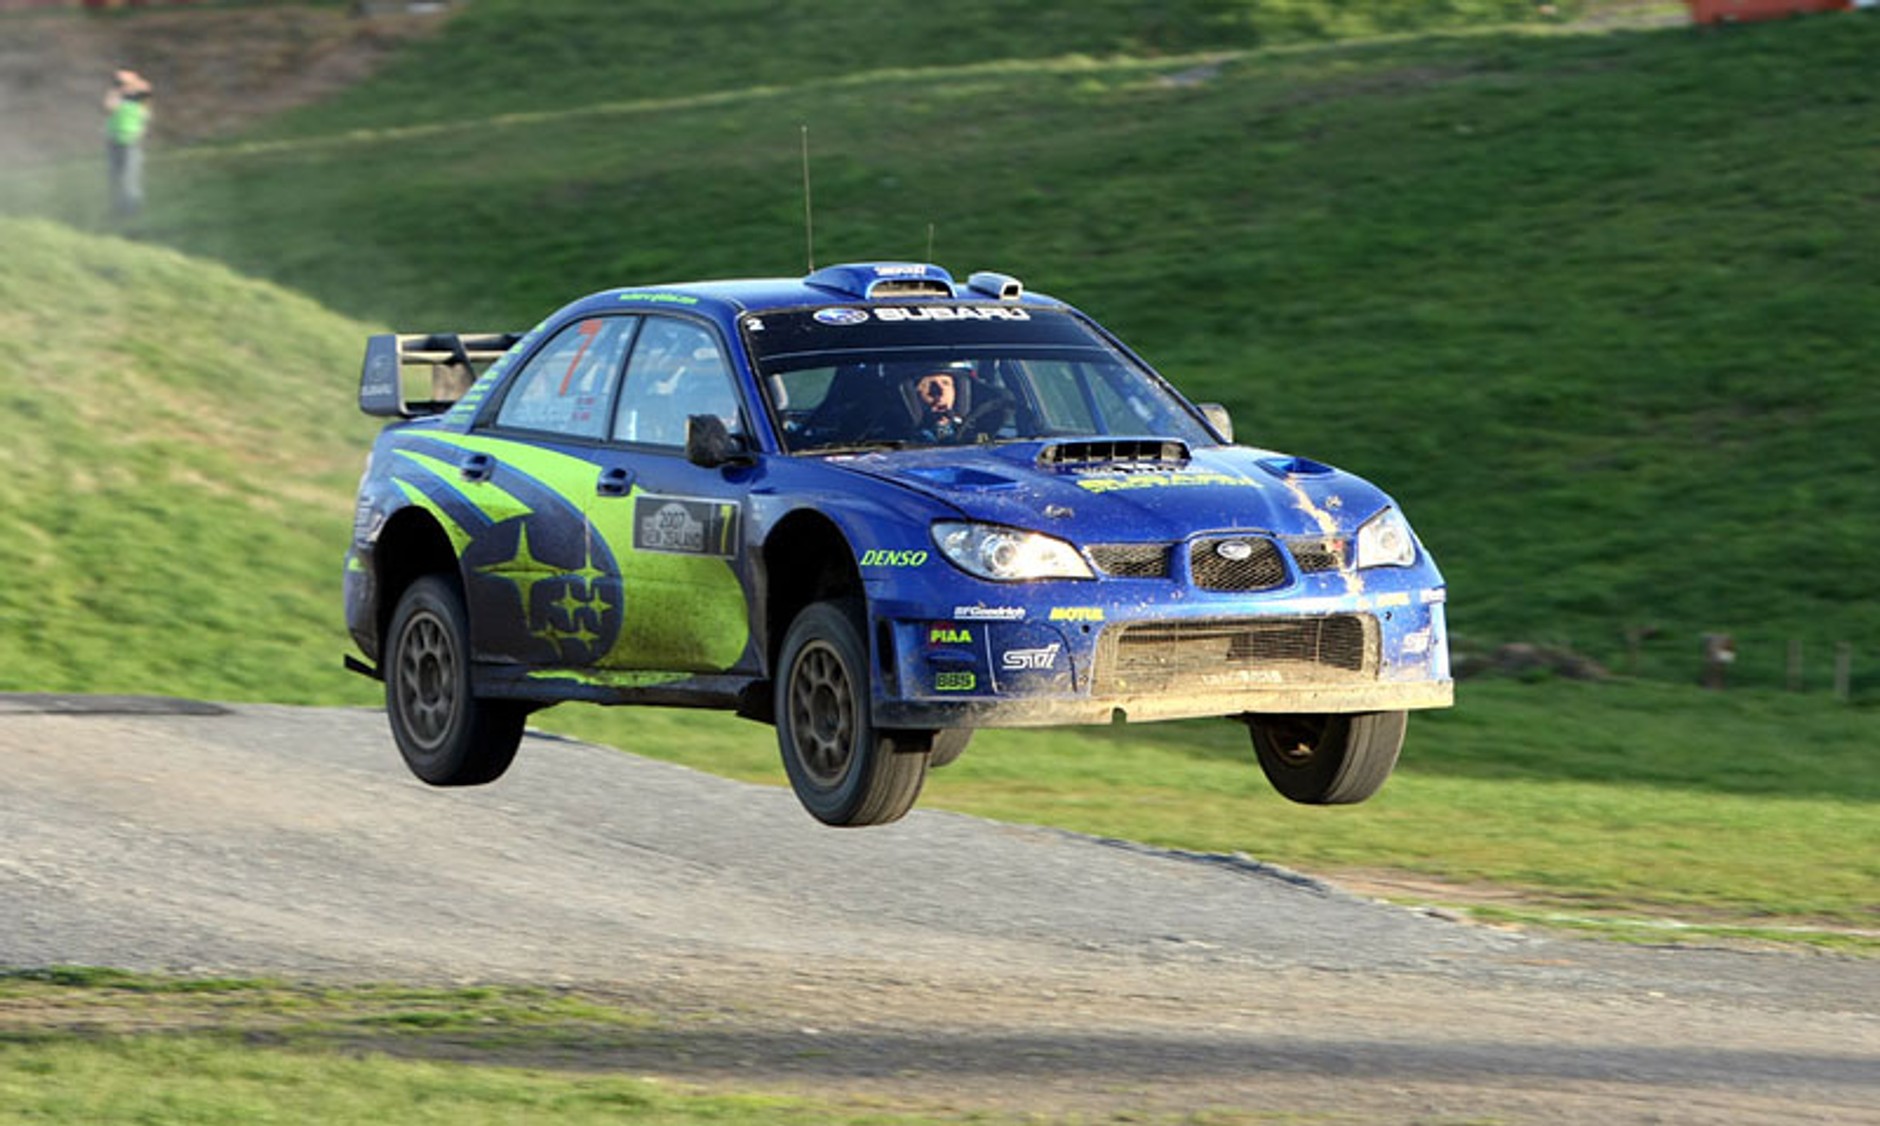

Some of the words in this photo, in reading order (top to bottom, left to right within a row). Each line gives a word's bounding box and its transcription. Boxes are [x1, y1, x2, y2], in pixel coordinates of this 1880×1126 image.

[874, 308, 1030, 321] SUBARU
[747, 318, 764, 330] 2
[558, 319, 603, 396] 7
[660, 511, 686, 529] 2007
[721, 505, 732, 553] 7
[860, 549, 928, 567] DENSO
[1050, 608, 1105, 621] MOTUL
[931, 629, 973, 643] PIAA
